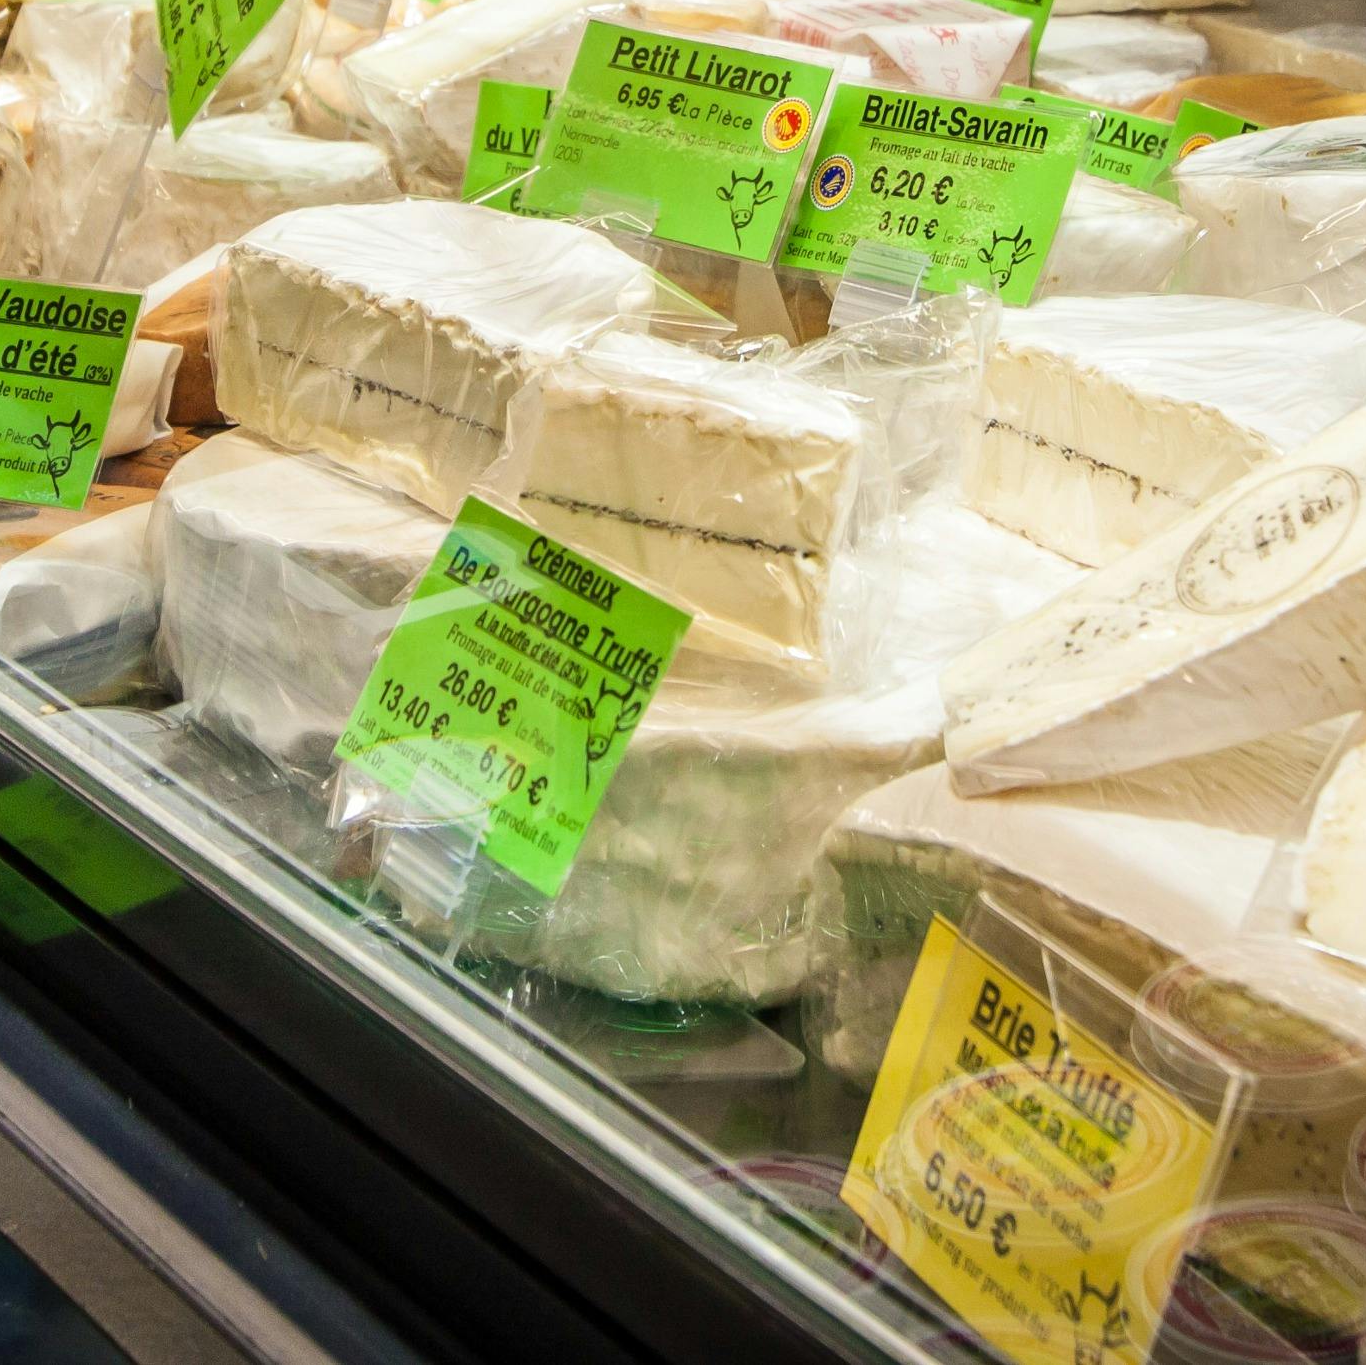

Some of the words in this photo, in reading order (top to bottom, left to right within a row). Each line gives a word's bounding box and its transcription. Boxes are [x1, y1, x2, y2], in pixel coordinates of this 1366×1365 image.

[611, 35, 681, 76] Petit
[684, 50, 792, 99] Livarot
[617, 82, 663, 110] 6,95
[707, 102, 753, 131] Pièce
[861, 93, 1049, 149] Brillat-Savarin
[486, 123, 513, 151] du
[561, 124, 620, 150] Normandie
[869, 136, 921, 161] Fromage
[922, 147, 937, 161] au
[940, 146, 960, 165] lait
[961, 150, 979, 168] de
[980, 153, 1015, 173] vache
[870, 165, 925, 201] 6,20
[931, 174, 953, 205] €
[793, 224, 813, 241] Lait
[816, 230, 835, 246] cru,
[878, 210, 919, 237] 3,10
[923, 218, 939, 240] €
[785, 241, 813, 261] Seine
[814, 246, 825, 262] et
[826, 249, 847, 266] Mar
[1, 338, 78, 377] d'été
[83, 364, 113, 384] (3%)
[15, 385, 54, 404] vache
[4, 427, 34, 446] Pièce
[525, 535, 621, 611] Crémeux
[448, 546, 478, 579] De
[479, 561, 591, 647] Bourgogne
[593, 626, 663, 689] Truffé
[498, 621, 531, 654] truffe
[439, 661, 497, 715] 26,80
[496, 697, 518, 727] €
[446, 622, 497, 667] Fromage
[495, 654, 513, 675] au
[512, 661, 534, 685] lait
[533, 675, 550, 695] de
[550, 689, 586, 721] vache
[379, 678, 430, 730] 13,40
[431, 713, 450, 741] €
[479, 744, 526, 792] 6,70
[526, 775, 549, 806] €
[356, 710, 378, 735] Lait
[494, 806, 542, 844] produit
[971, 978, 1037, 1057] Brie
[924, 1151, 987, 1230] 6,50
[989, 1211, 1018, 1258] €
